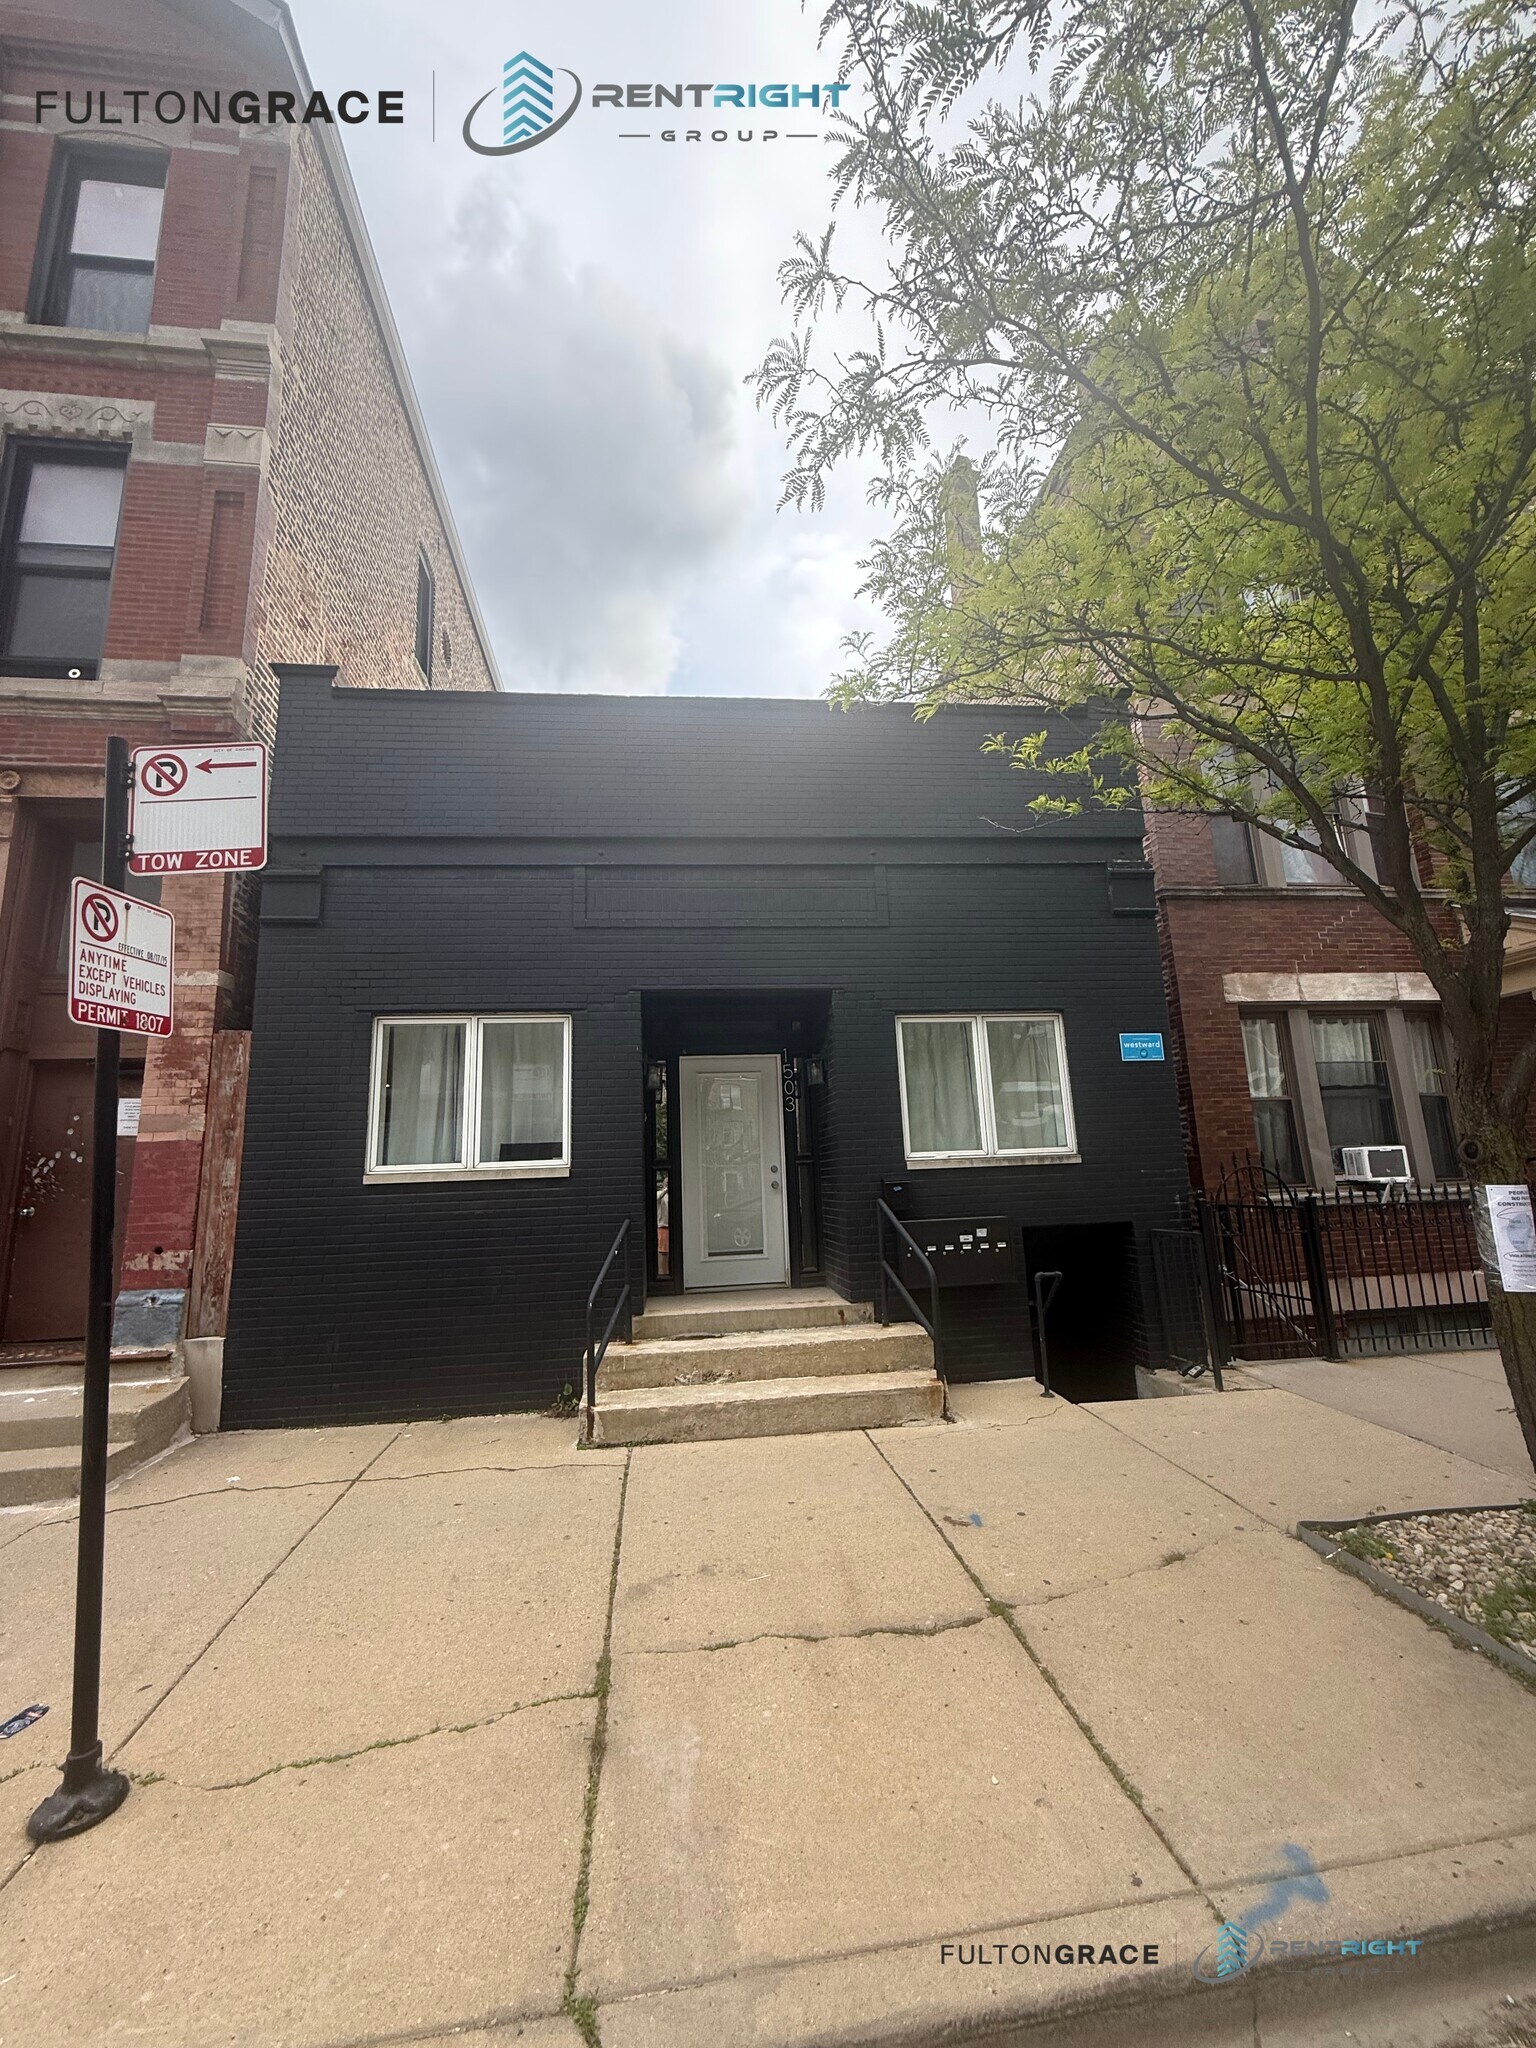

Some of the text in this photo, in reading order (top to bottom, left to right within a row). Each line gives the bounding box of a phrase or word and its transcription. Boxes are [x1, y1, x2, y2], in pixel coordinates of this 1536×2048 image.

[138, 849, 253, 871] TOW ZONE
[80, 948, 127, 972] ANYTIME
[118, 942, 144, 959] EFFECTIVE
[79, 964, 166, 997] EXCEPT VEHICLES
[78, 980, 136, 1005] DISPLAYING
[135, 1012, 164, 1033] 1807
[1123, 1040, 1161, 1048] westward
[782, 1047, 796, 1112] 1503
